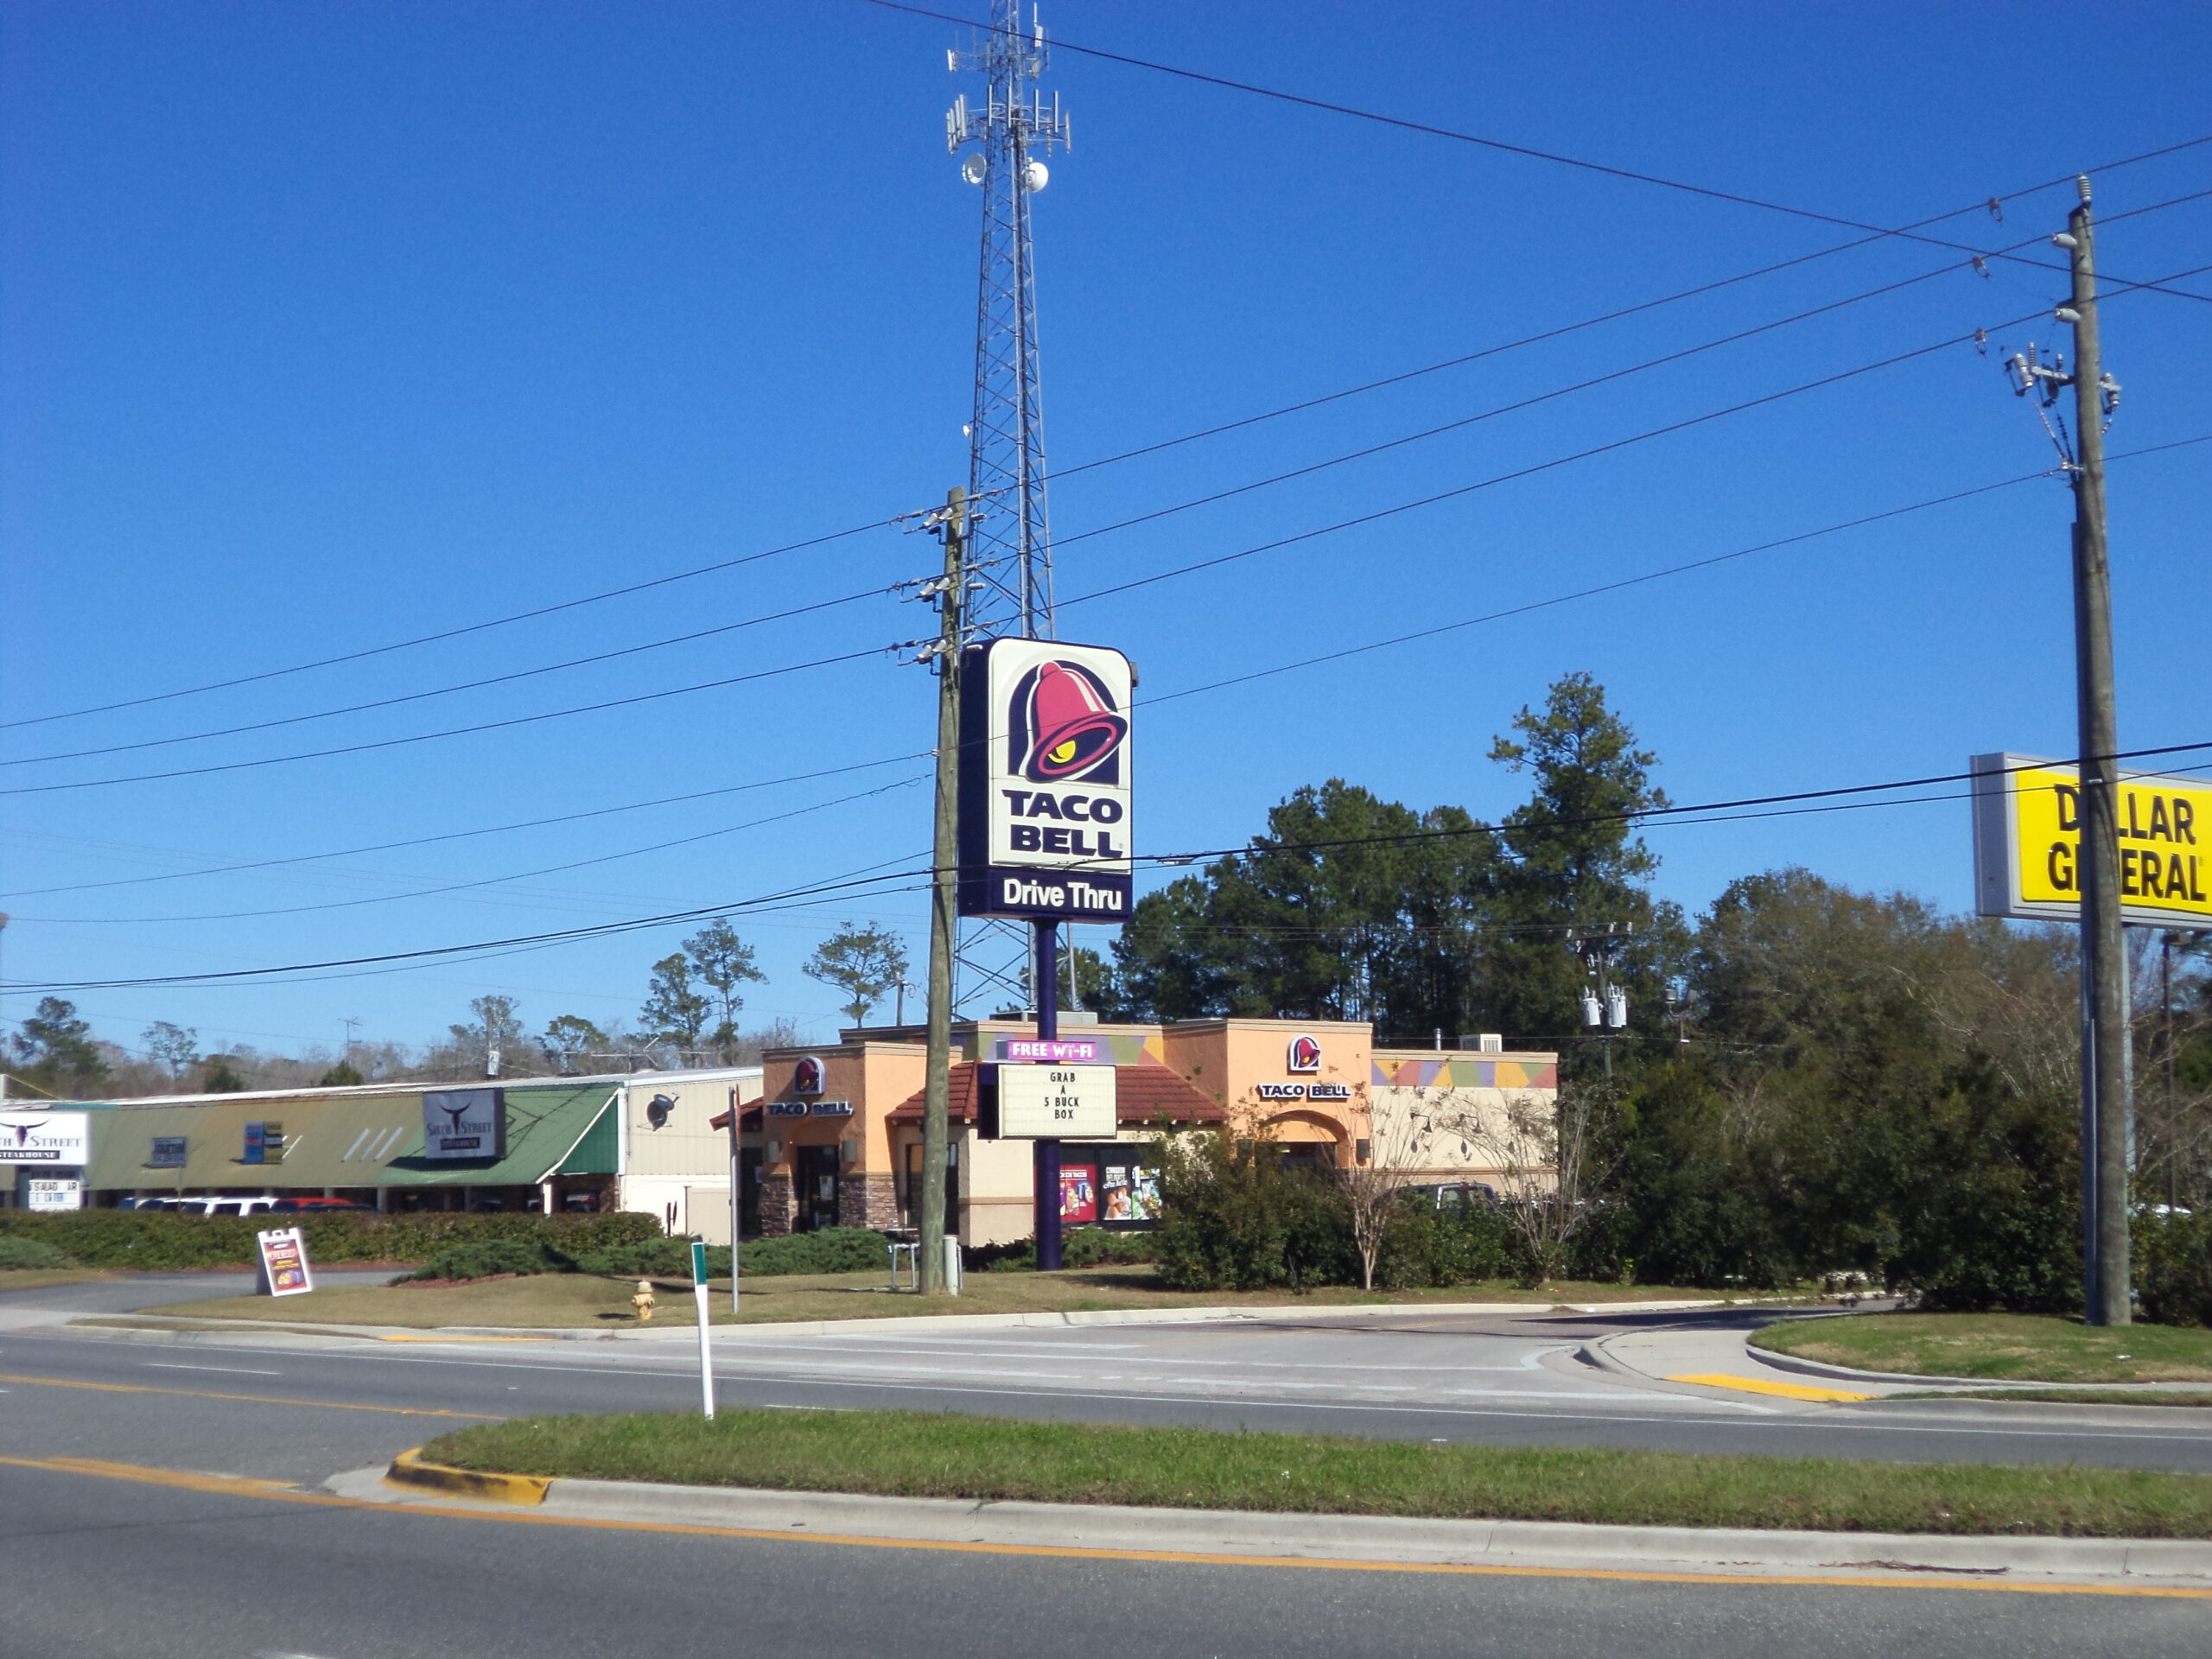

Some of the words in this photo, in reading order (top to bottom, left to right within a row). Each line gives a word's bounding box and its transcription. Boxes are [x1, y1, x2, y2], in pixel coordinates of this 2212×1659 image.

[1001, 789, 1122, 823] TACO
[2054, 784, 2196, 846] DLAR
[1010, 824, 1122, 859] BELL
[2048, 841, 2207, 902] GERAL
[1003, 878, 1065, 907] Drive
[1067, 881, 1122, 911] Thru
[1012, 1042, 1048, 1057] FREE
[1050, 1072, 1076, 1083] GRAB
[1060, 1084, 1066, 1095] A
[1261, 1084, 1306, 1096] TACO
[1311, 1084, 1351, 1096] BELL
[1055, 1096, 1079, 1107] BUCK
[766, 1102, 807, 1117] TACO
[812, 1102, 854, 1117] BELL
[1054, 1109, 1074, 1119] BOX
[30, 1135, 81, 1147] STREET
